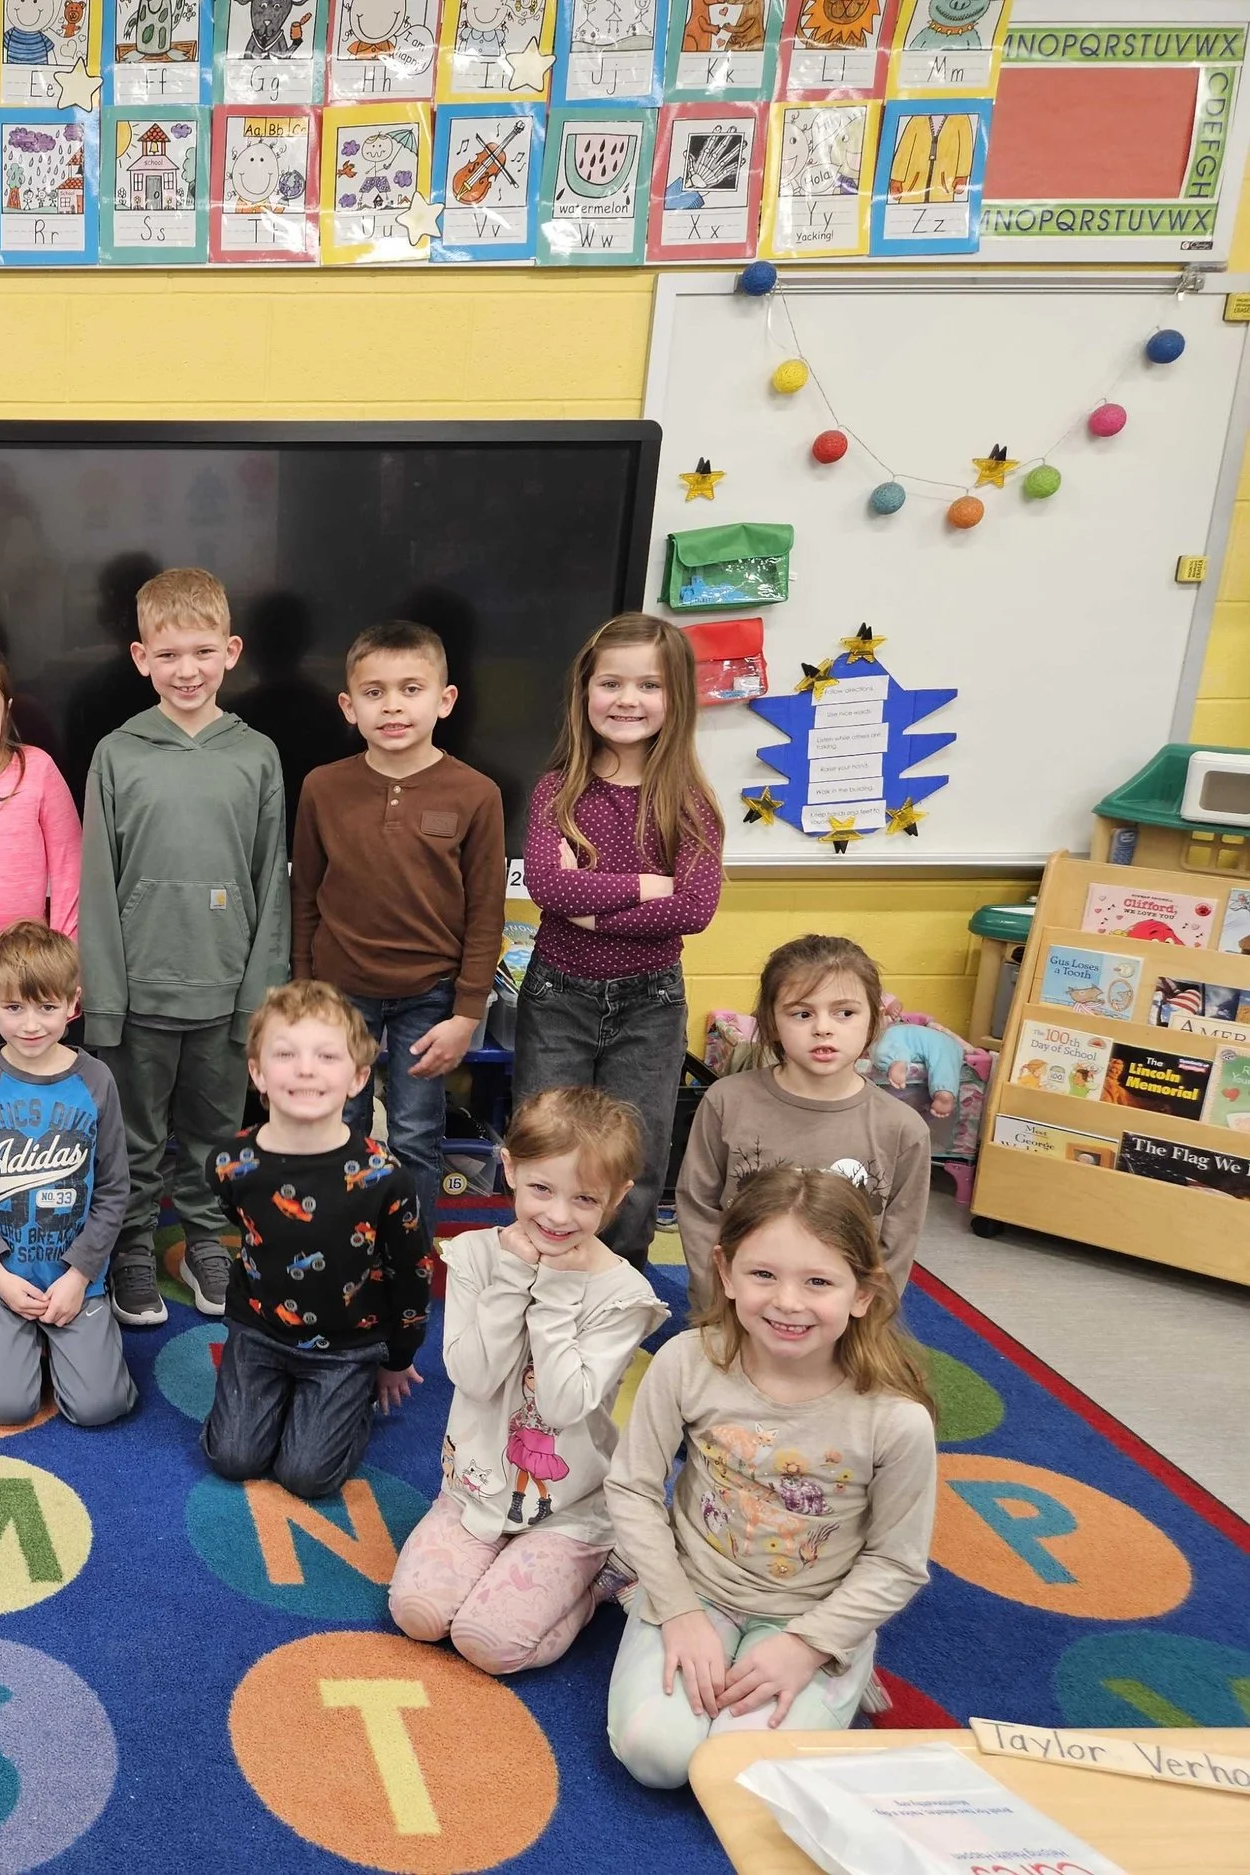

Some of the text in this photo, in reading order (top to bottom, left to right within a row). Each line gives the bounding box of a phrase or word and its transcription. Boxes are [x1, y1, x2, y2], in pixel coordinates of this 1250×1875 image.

[404, 31, 425, 52] I am
[363, 66, 391, 92] Hh
[591, 58, 618, 95] Jj
[707, 57, 735, 83] Kk
[927, 56, 964, 82] Mm
[30, 70, 55, 98] Ee
[250, 66, 280, 100] Gg
[245, 124, 261, 136] Aa
[269, 124, 283, 135] Bb
[140, 216, 165, 241] Ss
[474, 213, 500, 238] Vv
[688, 215, 719, 239] Xx
[807, 201, 833, 232] Yy
[912, 208, 945, 233] Zz
[34, 219, 59, 244] Rr
[578, 222, 613, 248] Ww
[796, 230, 834, 243] Yacking!
[510, 871, 522, 886] 2
[1050, 956, 1099, 972] Gus Loses
[1063, 967, 1091, 979] Tooth
[1031, 1040, 1097, 1060] Day of School
[1146, 1057, 1164, 1067] The
[1129, 1063, 1181, 1083] Lincoln
[1126, 1076, 1200, 1100] Memorial
[1015, 1133, 1055, 1151] George
[1025, 1125, 1047, 1137] Meet
[1132, 1137, 1168, 1157] The
[1173, 1148, 1210, 1171] Flag
[1215, 1156, 1242, 1174] We
[41, 1191, 73, 1205] NO. 33
[242, 1480, 402, 1586] N
[946, 1480, 1077, 1584] P
[983, 1721, 1108, 1763] Taylor
[318, 1679, 440, 1835] T
